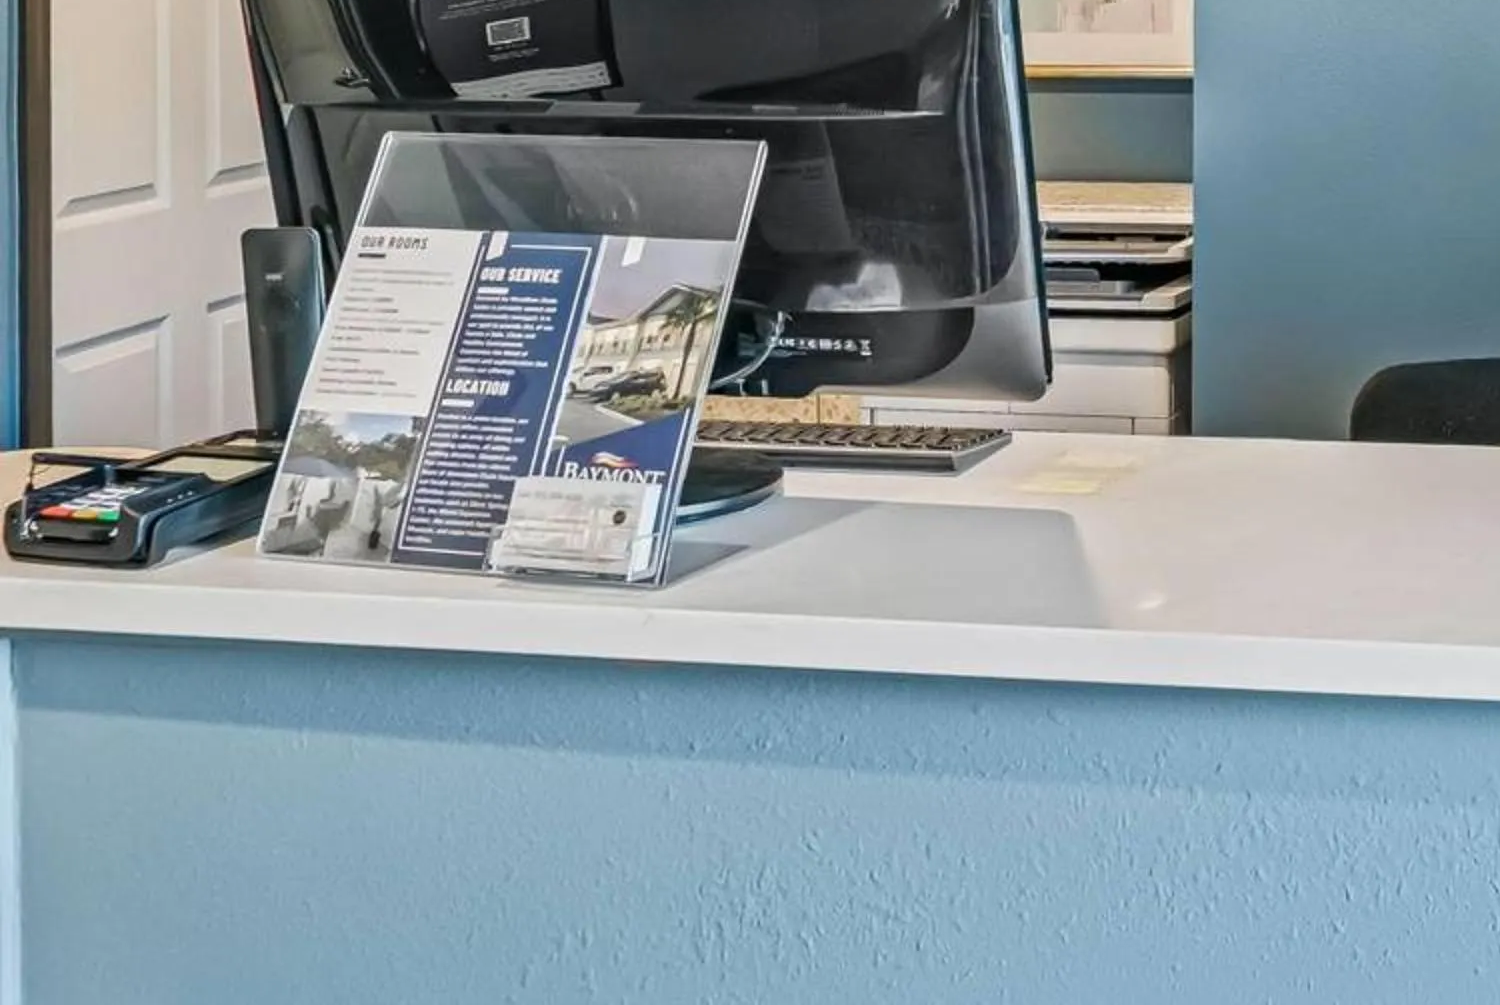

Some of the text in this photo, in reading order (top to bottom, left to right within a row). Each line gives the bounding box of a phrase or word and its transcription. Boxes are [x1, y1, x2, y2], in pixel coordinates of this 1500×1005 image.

[388, 236, 429, 250] ROOMS
[479, 266, 563, 284] OUR SERVICE
[446, 379, 511, 396] LOCATION
[564, 461, 667, 485] BAYMONT
